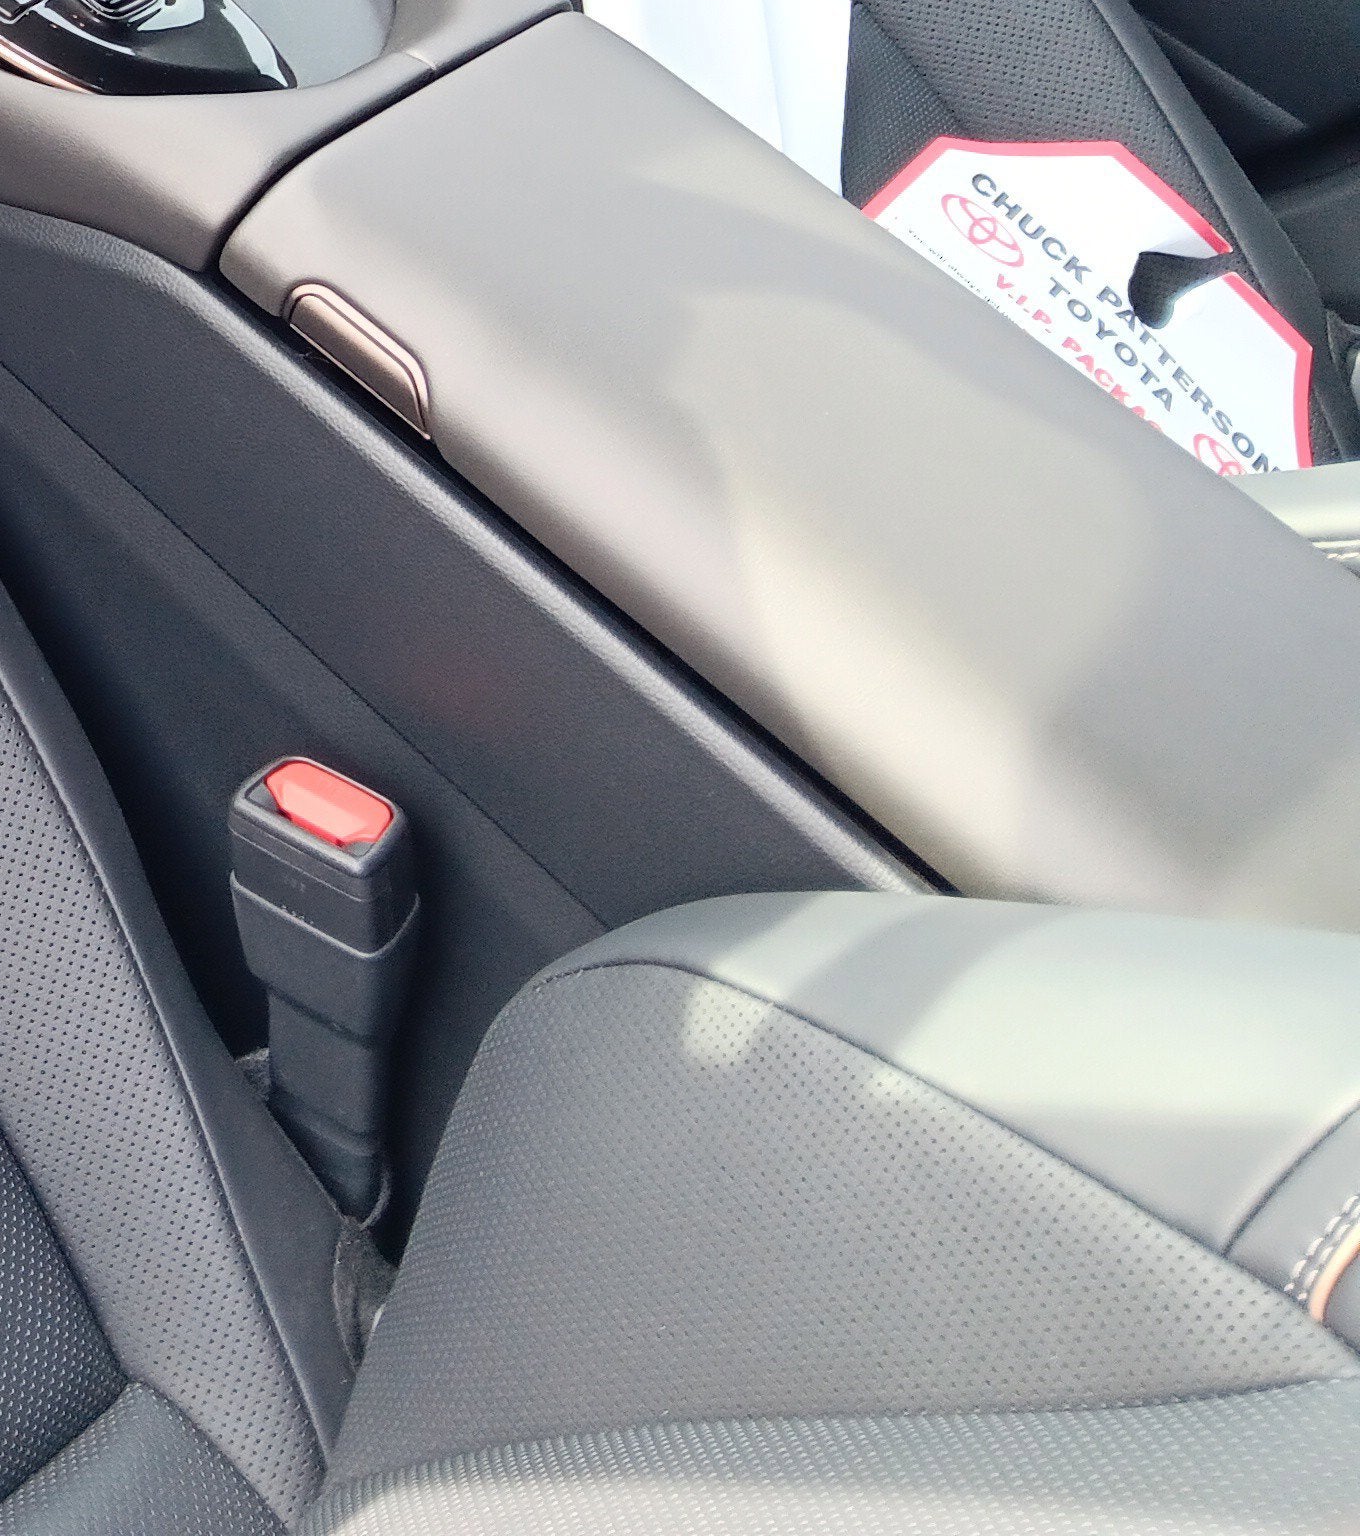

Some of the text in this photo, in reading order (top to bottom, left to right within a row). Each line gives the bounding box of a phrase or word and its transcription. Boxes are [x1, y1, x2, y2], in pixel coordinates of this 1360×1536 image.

[971, 172, 1092, 285] CHUCK
[1095, 285, 1281, 473] PATTERSON
[1046, 276, 1175, 413] TOYOTA
